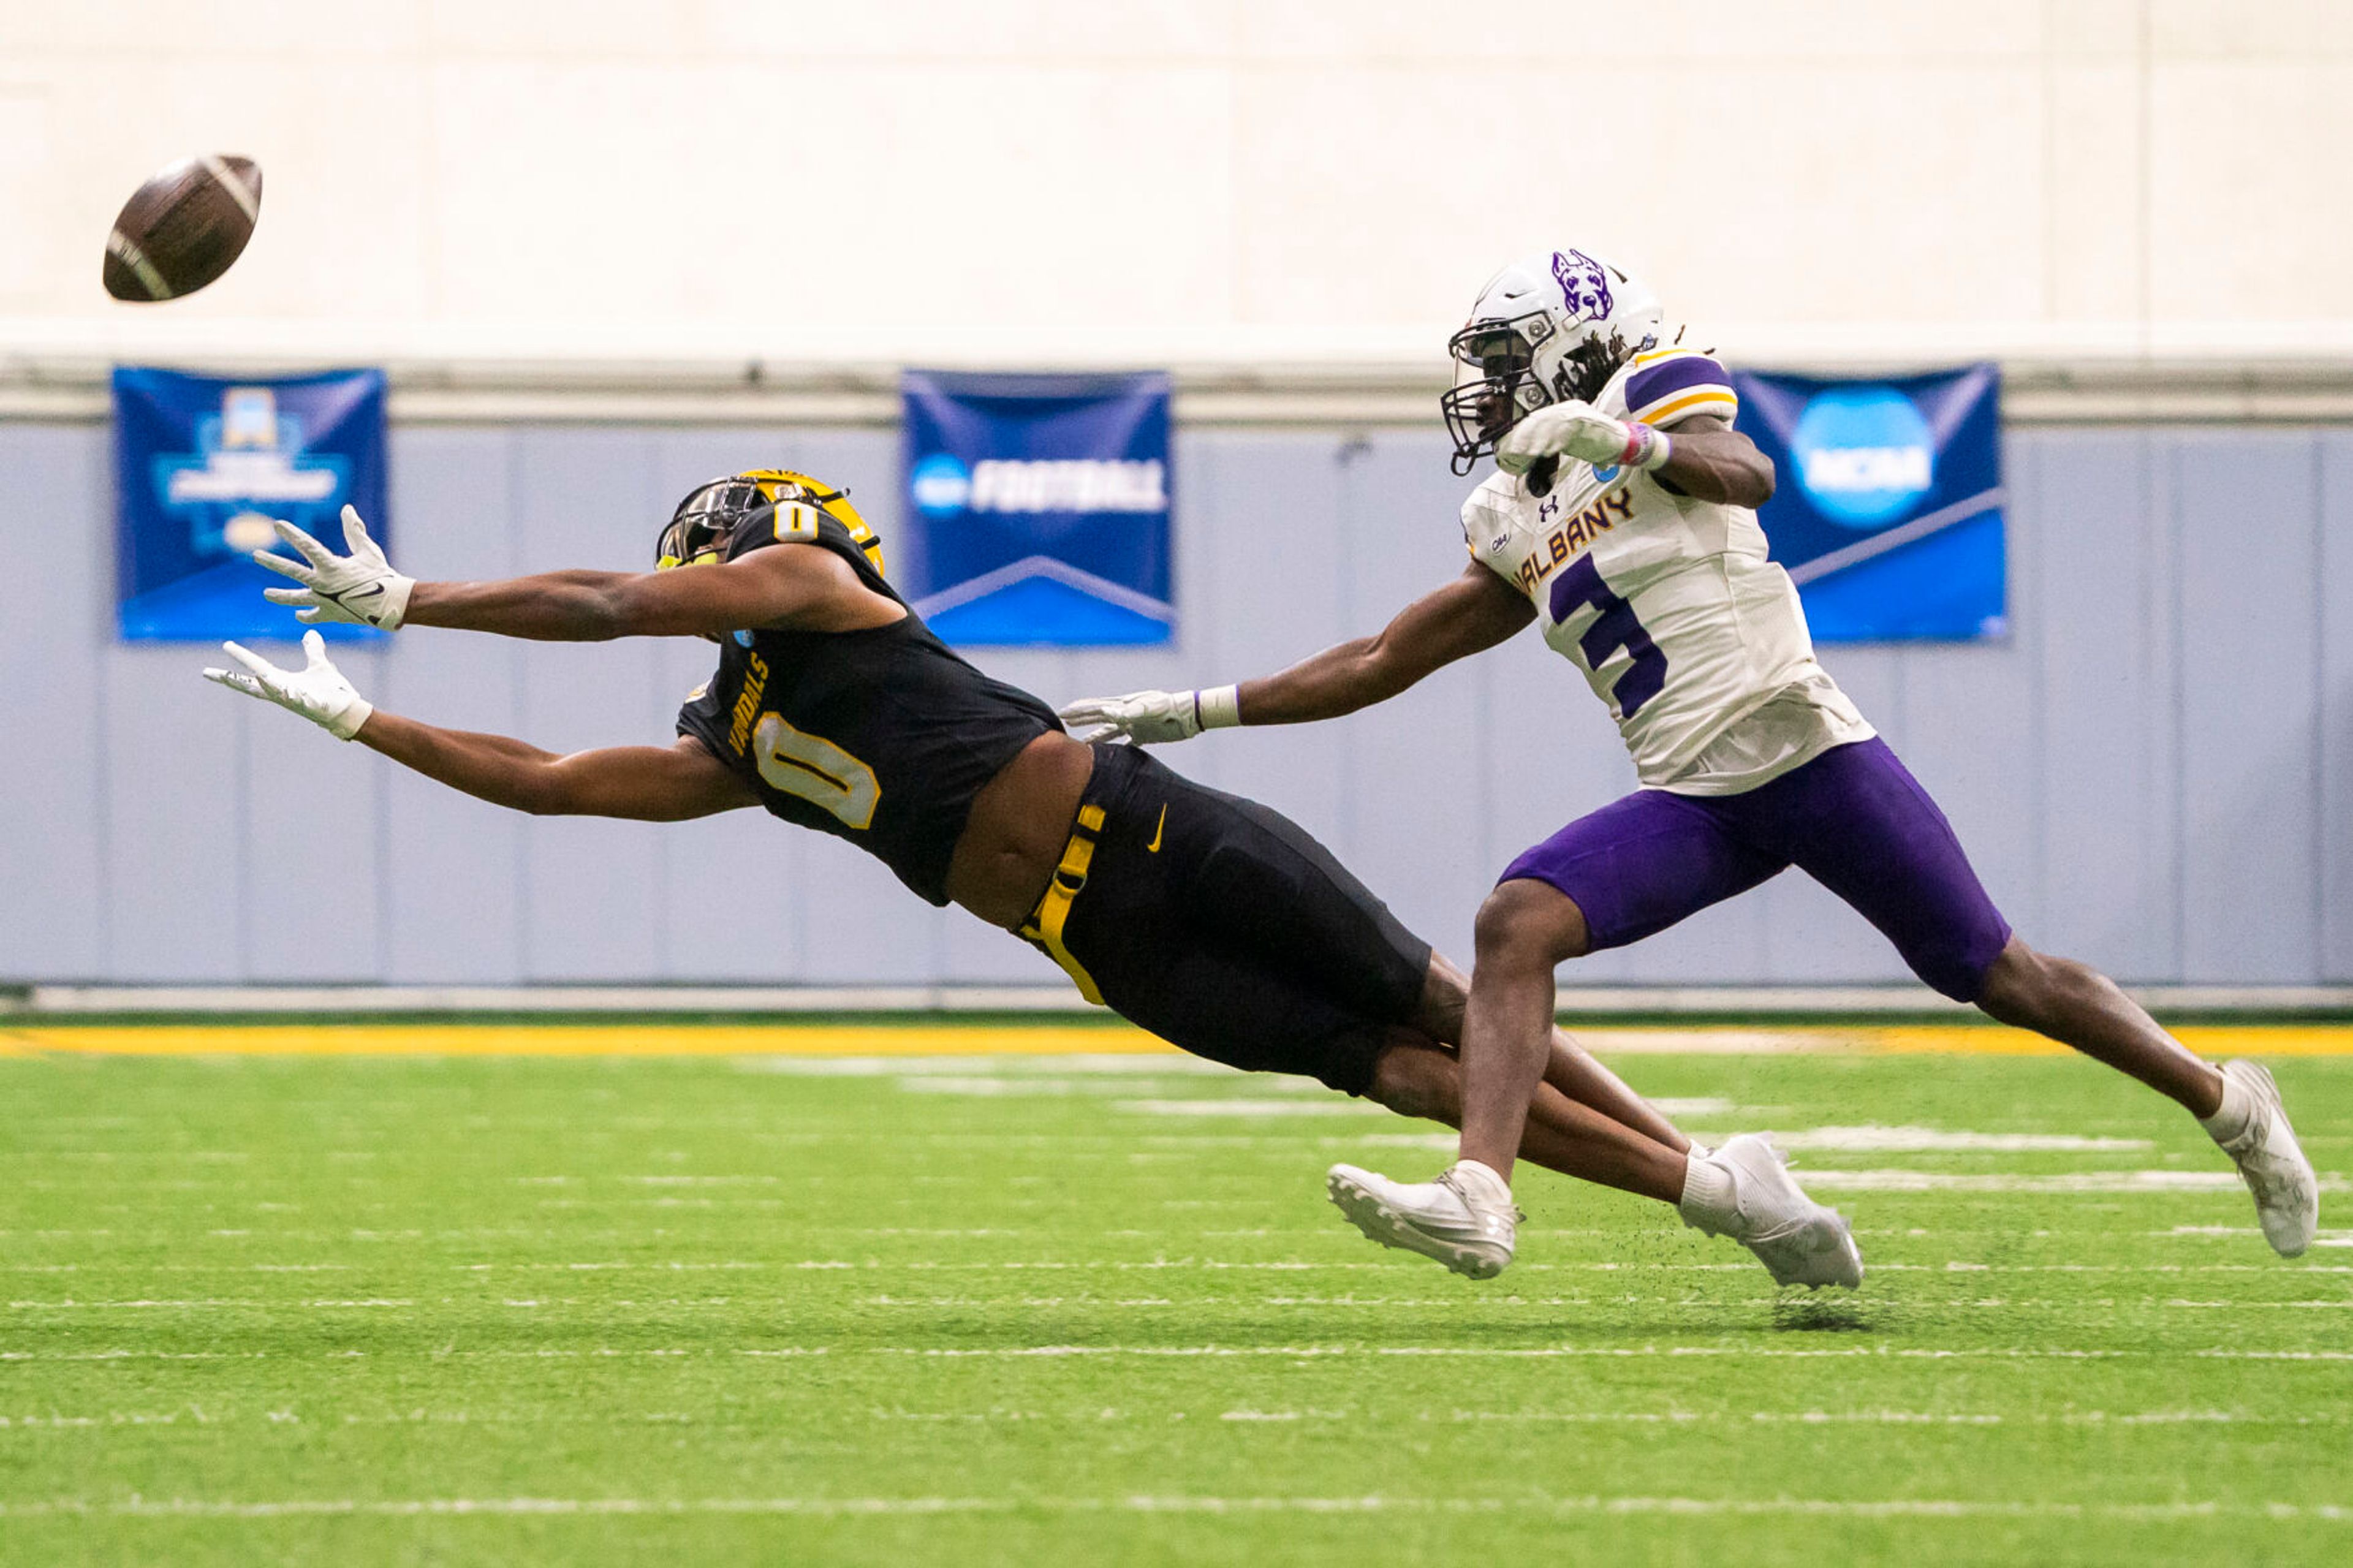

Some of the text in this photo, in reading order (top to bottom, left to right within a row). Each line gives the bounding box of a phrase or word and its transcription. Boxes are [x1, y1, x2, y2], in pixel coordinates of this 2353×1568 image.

[773, 500, 819, 543] 0
[1549, 551, 1669, 719] 3
[753, 710, 882, 830] 0
